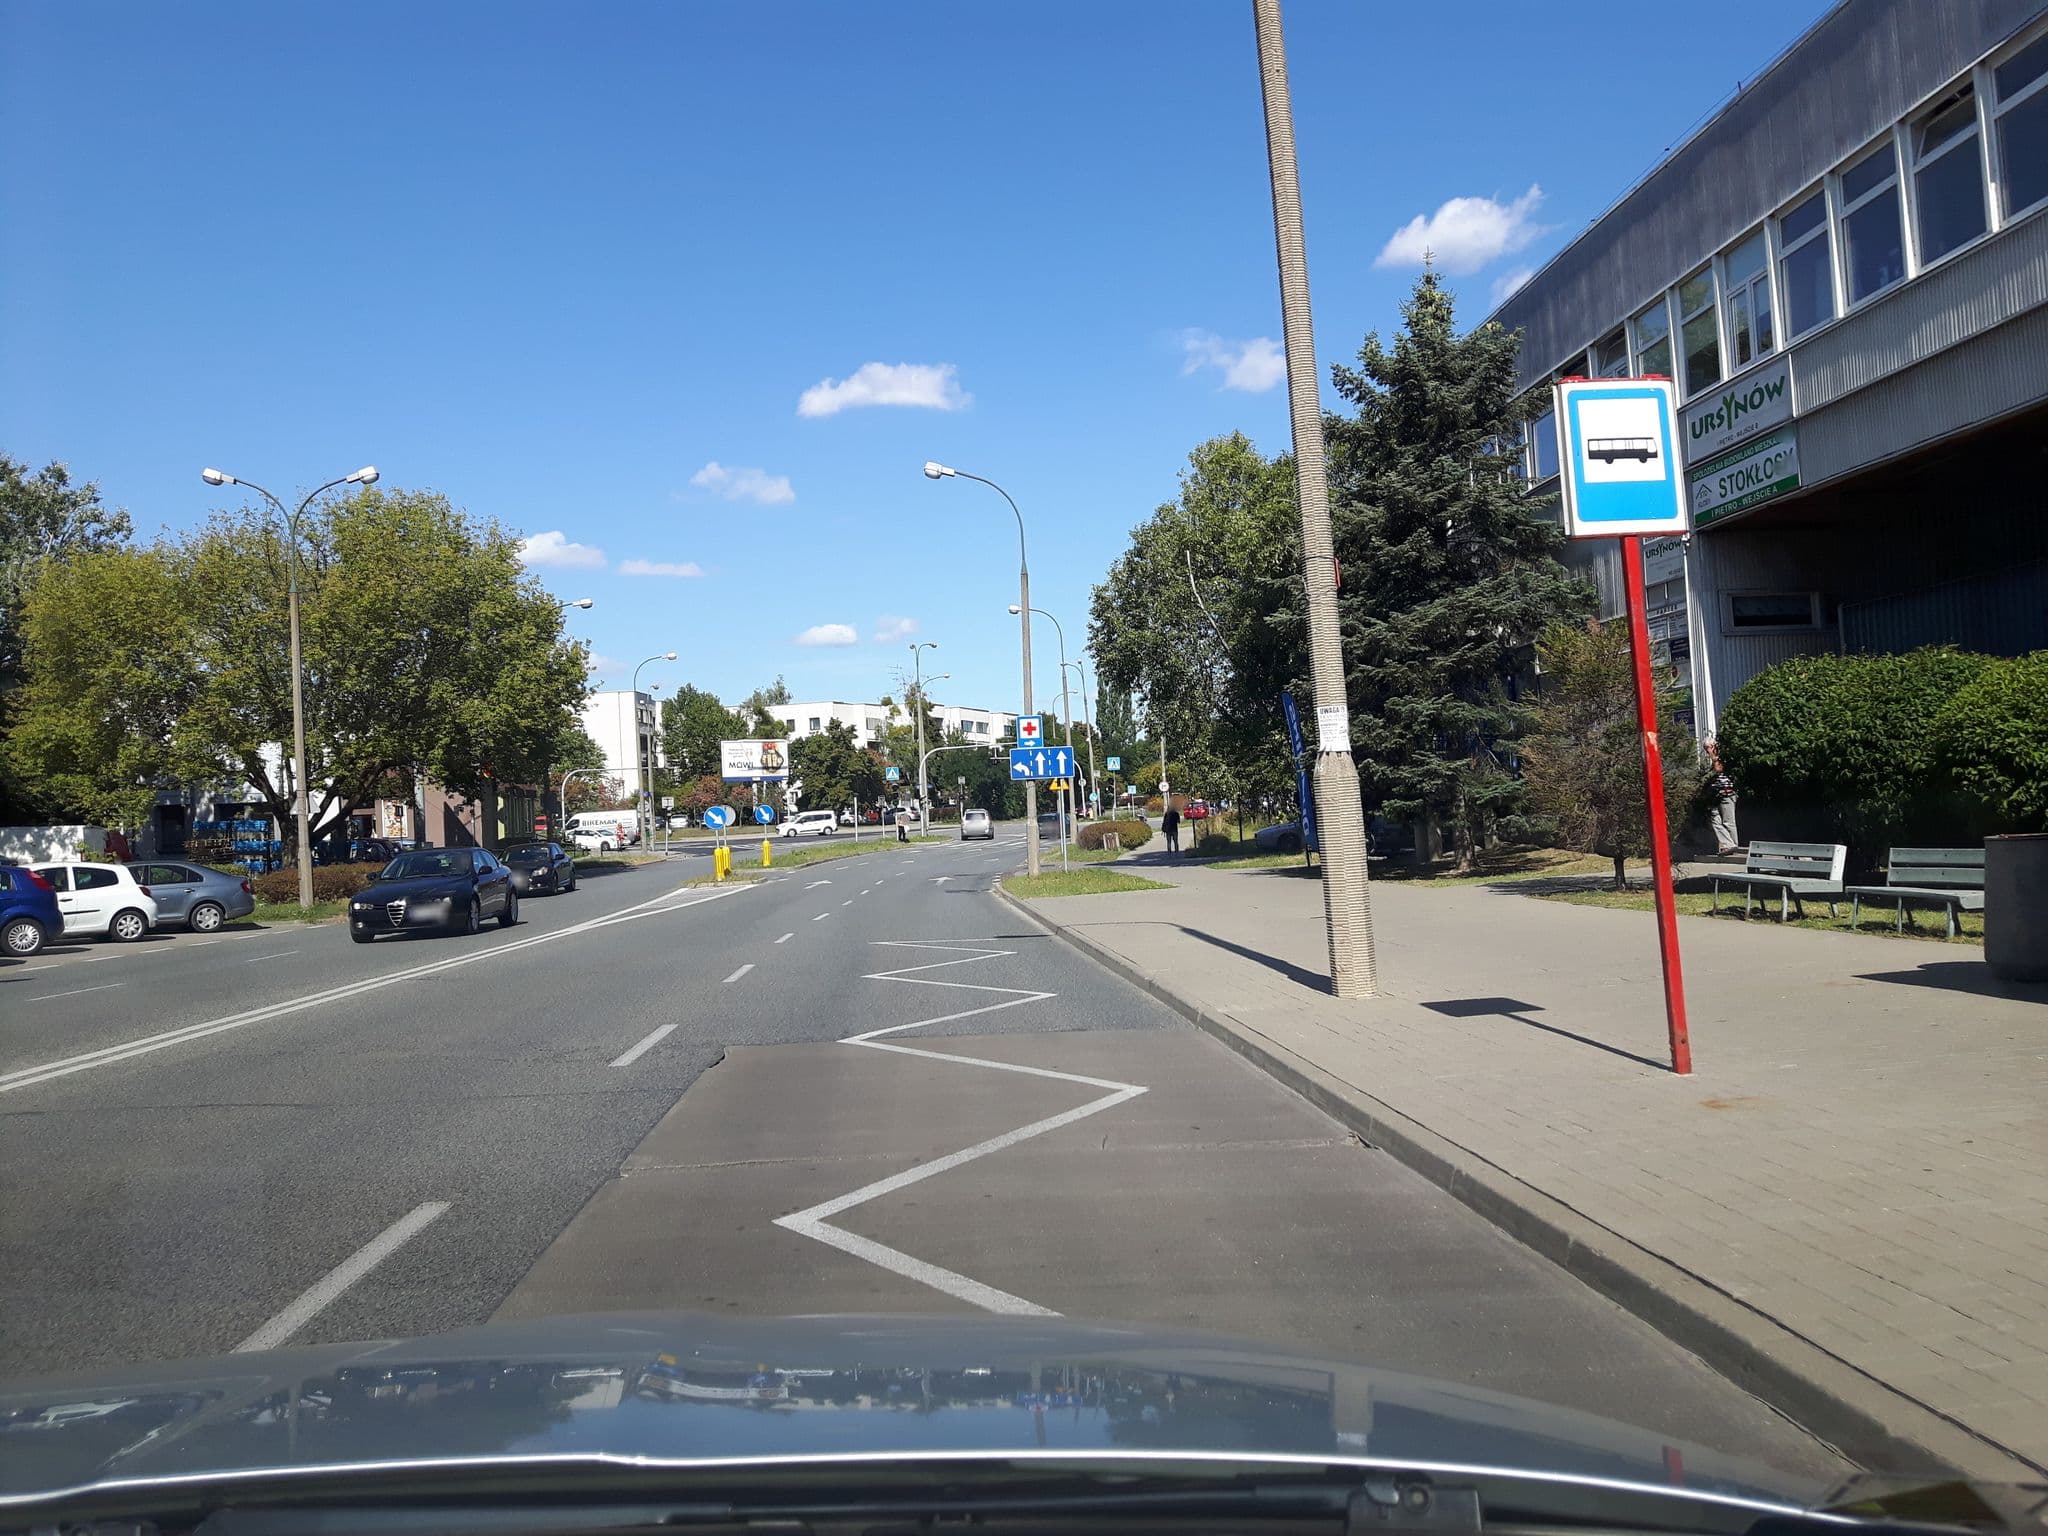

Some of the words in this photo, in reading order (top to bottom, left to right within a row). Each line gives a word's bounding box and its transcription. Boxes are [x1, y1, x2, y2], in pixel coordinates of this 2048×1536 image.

[1691, 376, 1785, 439] URSYNÓW
[1771, 485, 1778, 493] A
[581, 818, 618, 827] BIKEMAN
